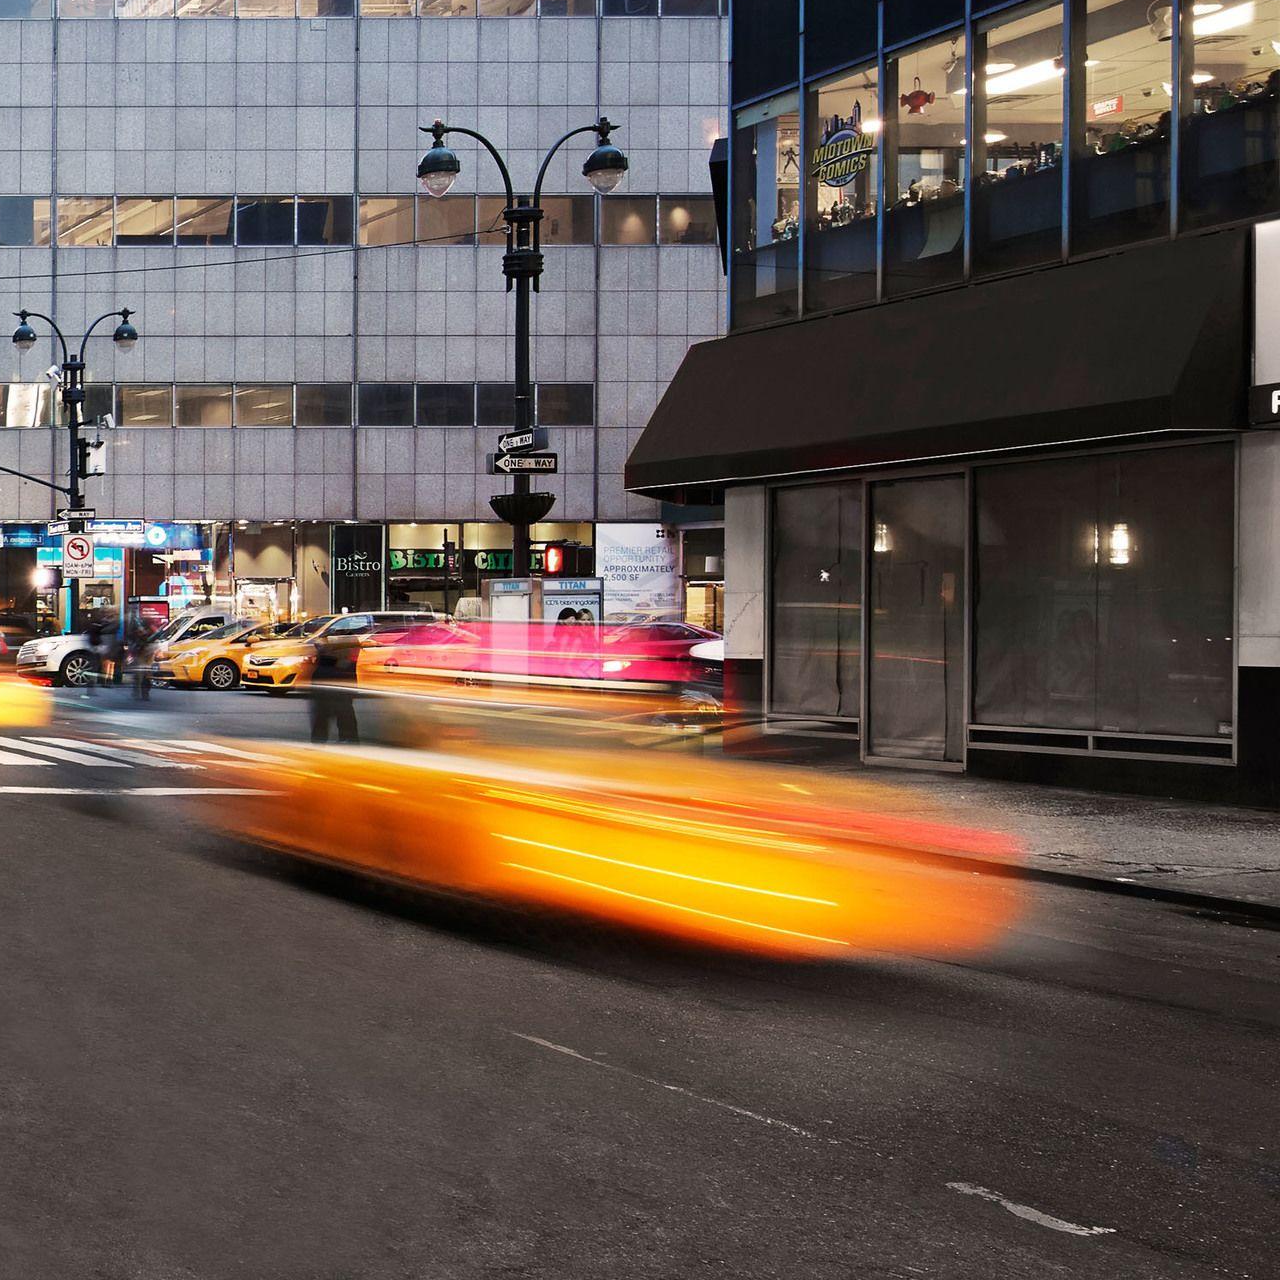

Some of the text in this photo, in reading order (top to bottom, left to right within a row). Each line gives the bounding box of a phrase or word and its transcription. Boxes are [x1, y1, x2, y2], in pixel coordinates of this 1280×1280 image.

[812, 133, 874, 164] MIDTOWN
[819, 154, 867, 182] COMICS
[502, 435, 531, 449] ONE WAY
[503, 459, 553, 468] ONE WAY
[603, 546, 674, 555] PREMIER RETAIL
[336, 557, 381, 571] Bistro
[603, 565, 675, 573] APPROXIMATELY
[603, 573, 640, 582] 2,500 SF
[559, 581, 587, 589] TITAN
